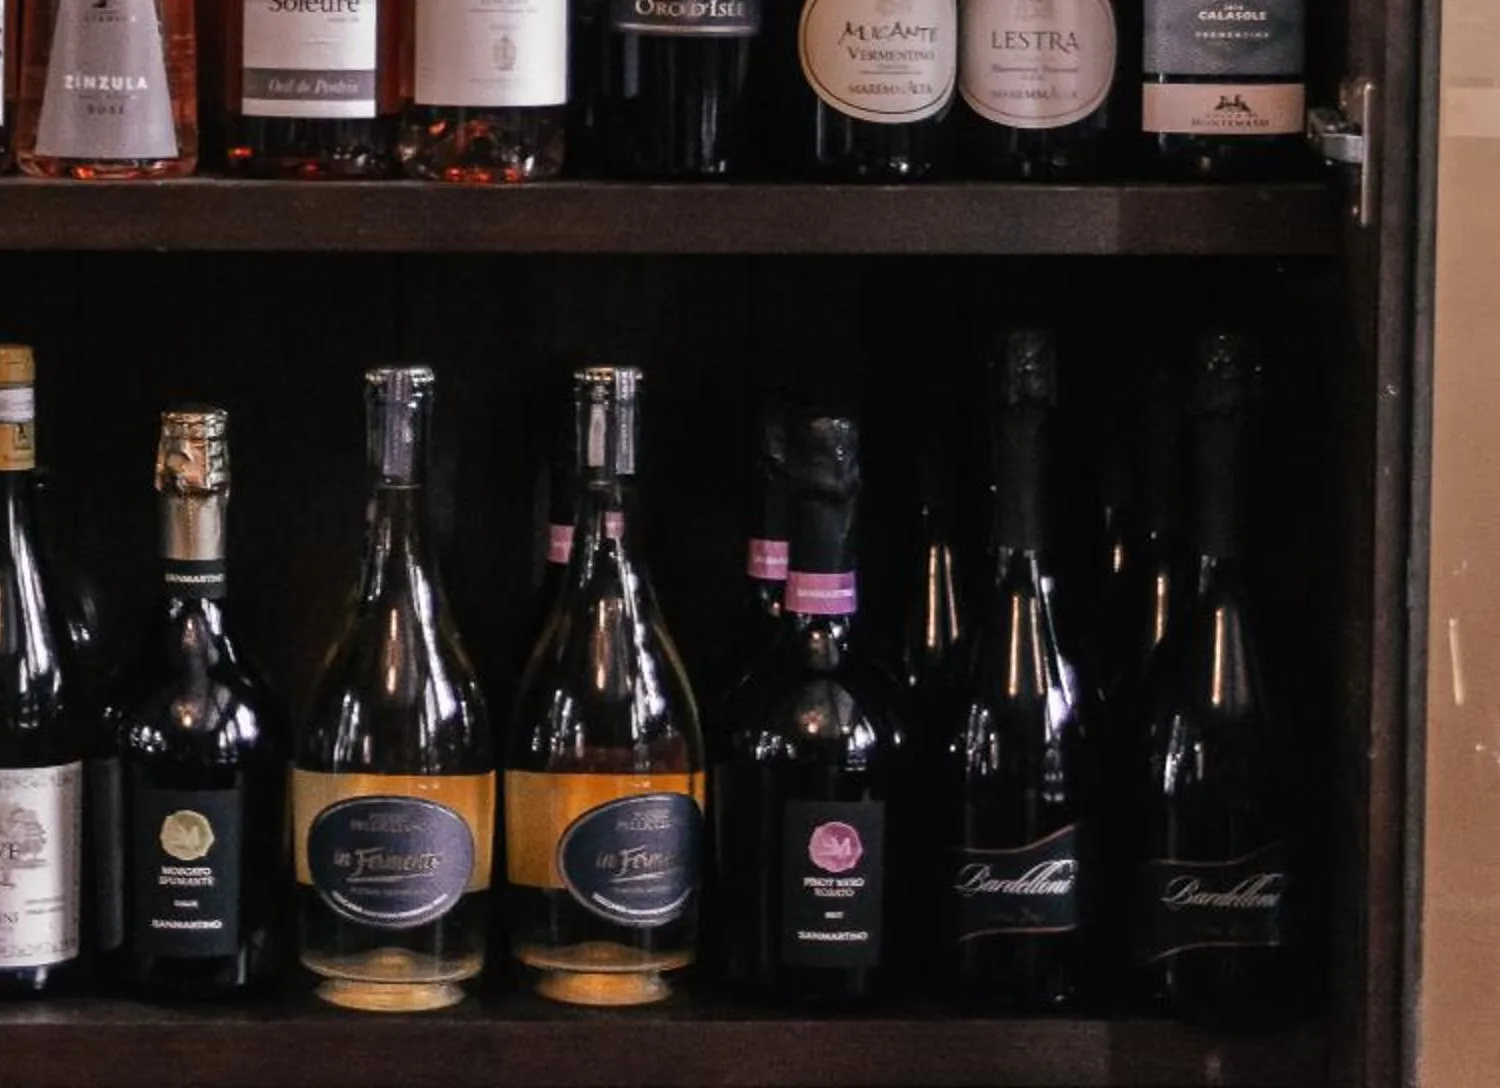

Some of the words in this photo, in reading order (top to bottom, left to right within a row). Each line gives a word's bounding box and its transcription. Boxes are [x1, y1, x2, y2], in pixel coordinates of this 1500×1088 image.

[991, 30, 1081, 54] LESTRA
[846, 45, 934, 61] VERMENTINO
[63, 74, 149, 90] ZINZULA
